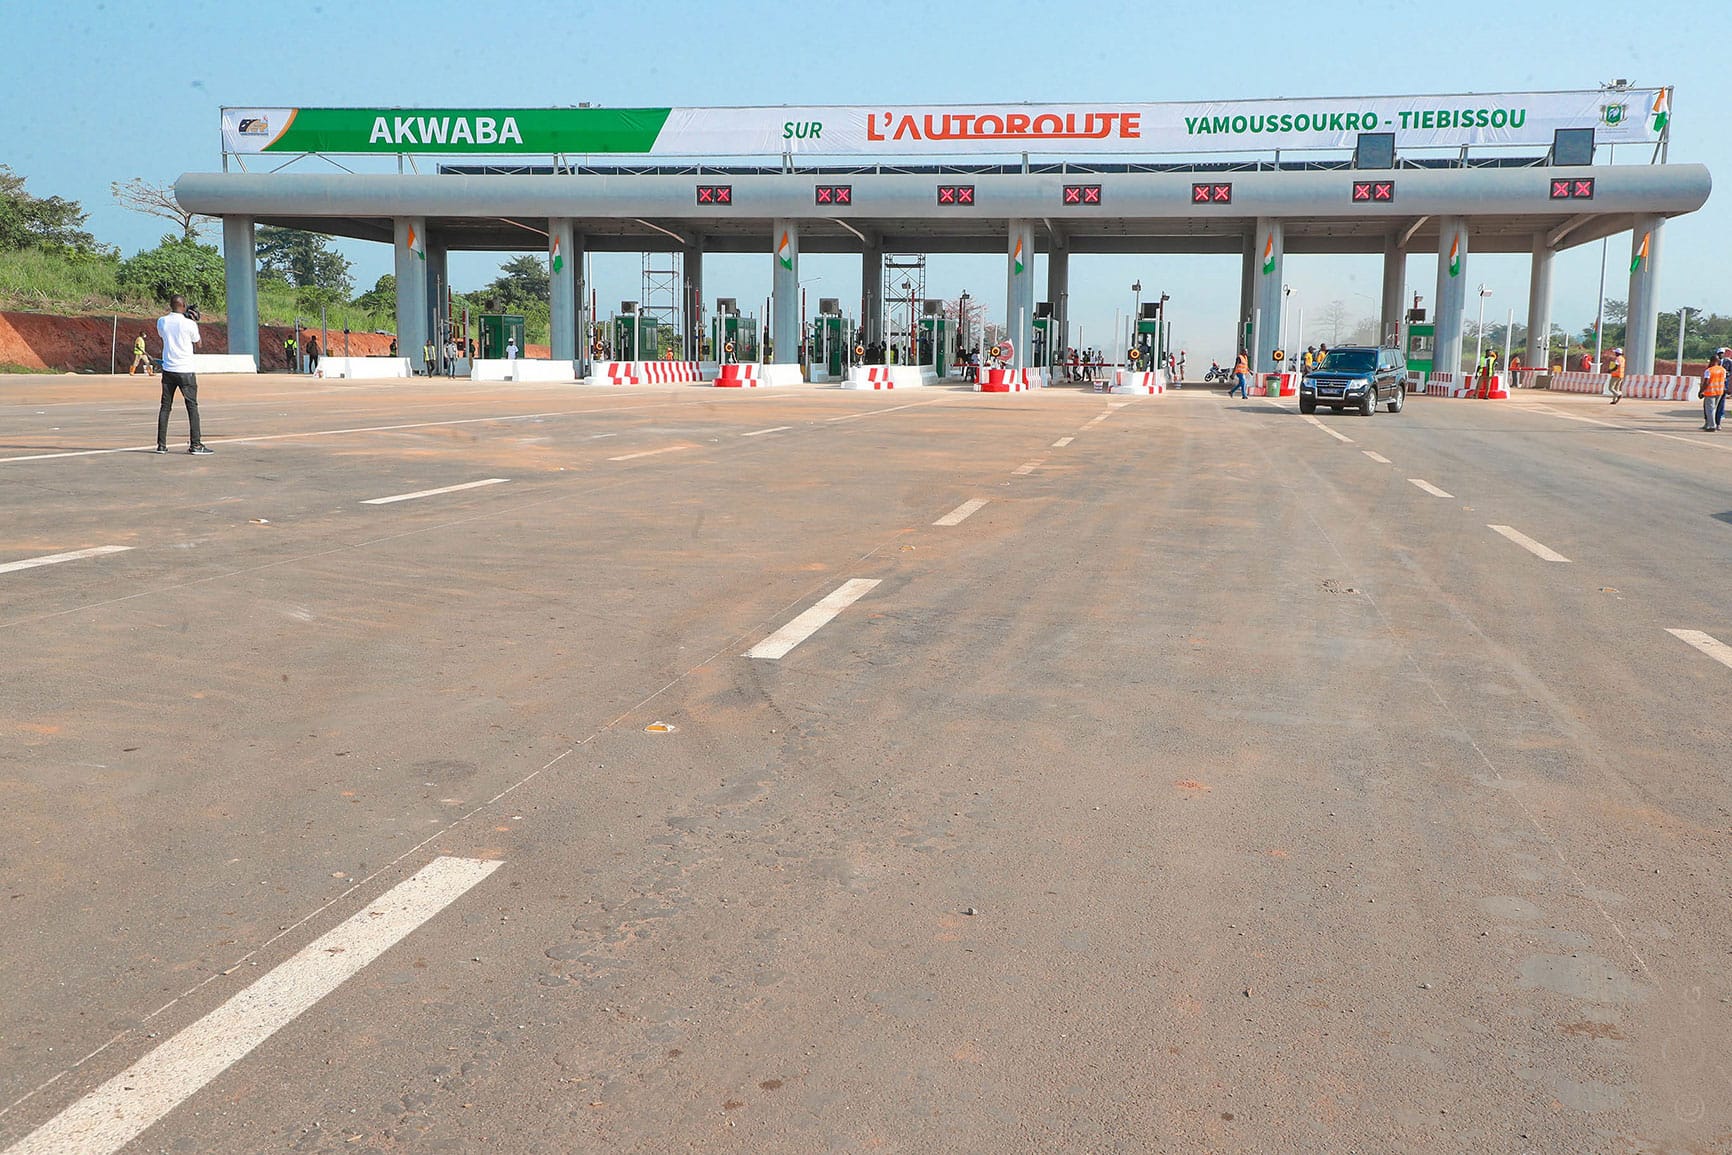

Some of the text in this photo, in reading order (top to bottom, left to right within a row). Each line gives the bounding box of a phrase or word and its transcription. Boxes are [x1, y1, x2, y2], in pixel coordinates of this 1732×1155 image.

[369, 117, 524, 144] AKWABA
[783, 121, 823, 139] SUR
[1184, 111, 1378, 136] YAMOUSSOUKRO
[1398, 108, 1526, 130] TIEBISSOU
